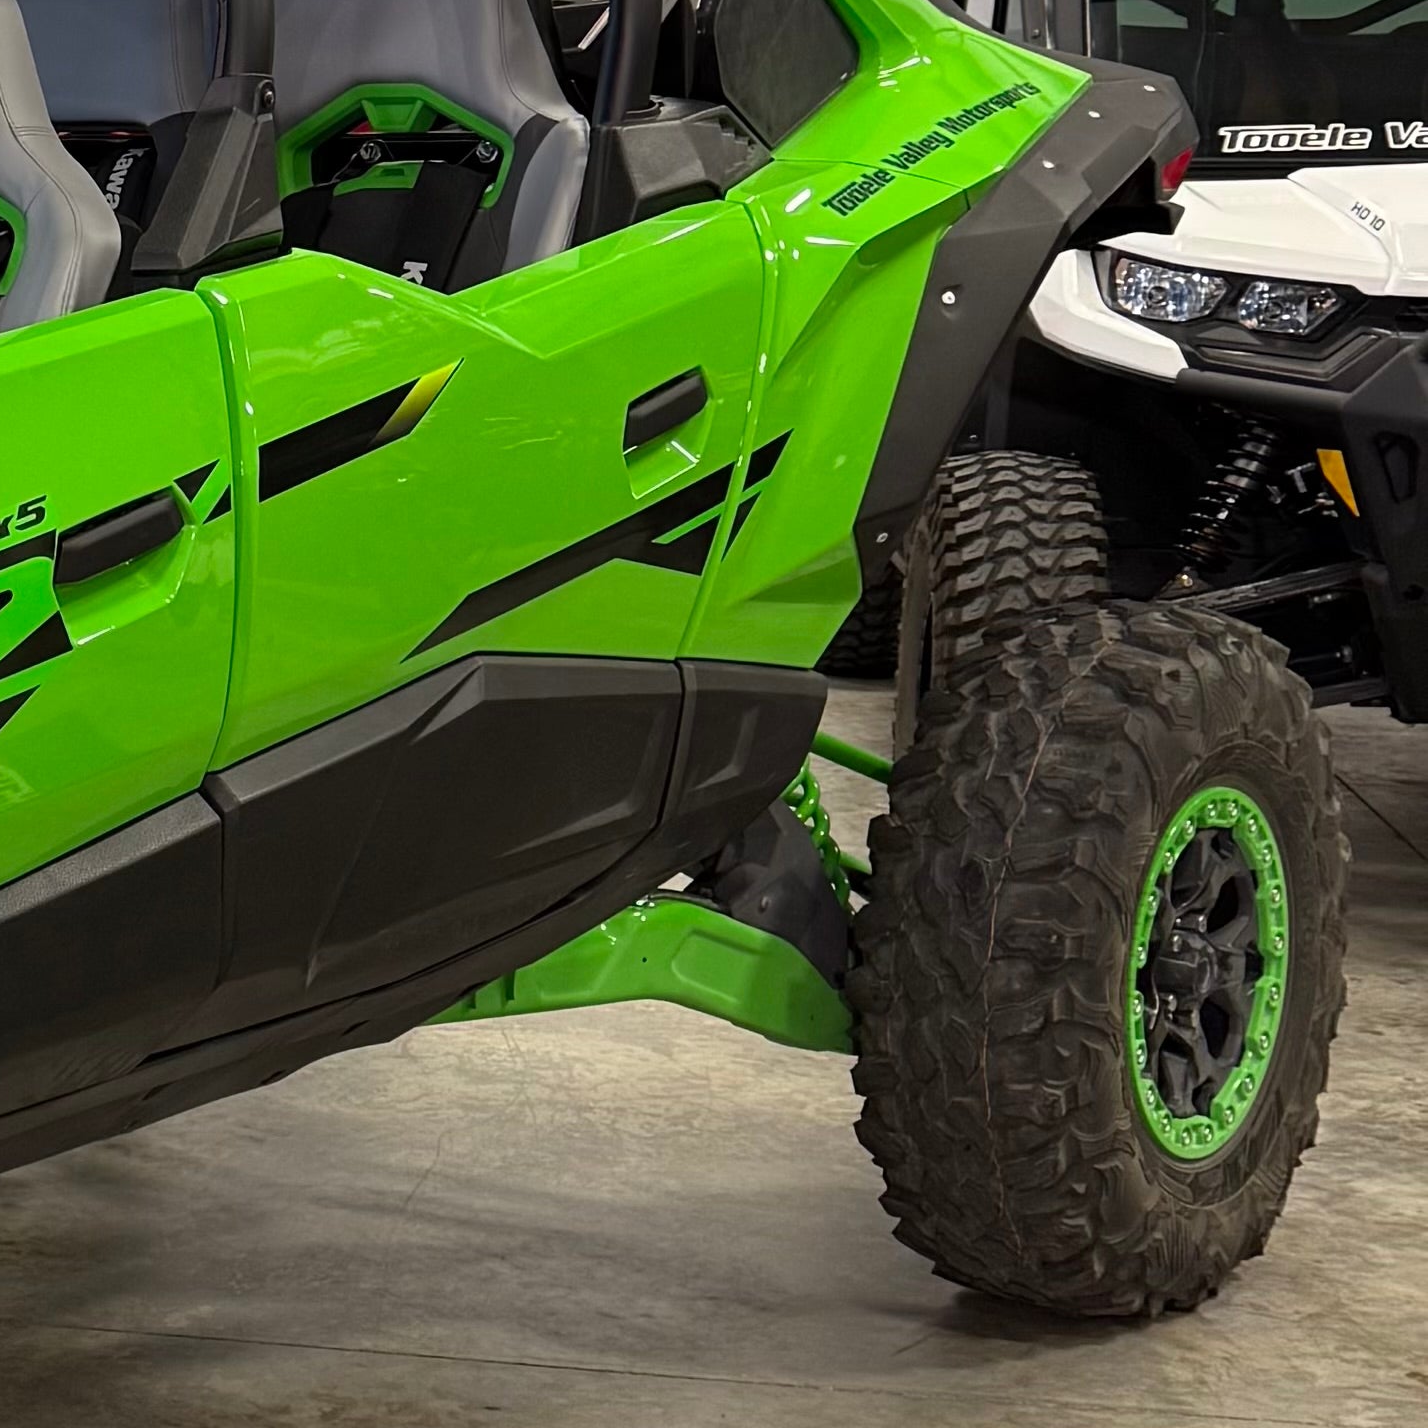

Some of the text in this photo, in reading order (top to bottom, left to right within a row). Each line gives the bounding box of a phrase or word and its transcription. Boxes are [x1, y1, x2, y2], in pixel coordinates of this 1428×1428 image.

[820, 81, 1042, 217] Tooele Valley Motorsports
[1218, 123, 1373, 153] Tooele
[1371, 214, 1387, 233] 10
